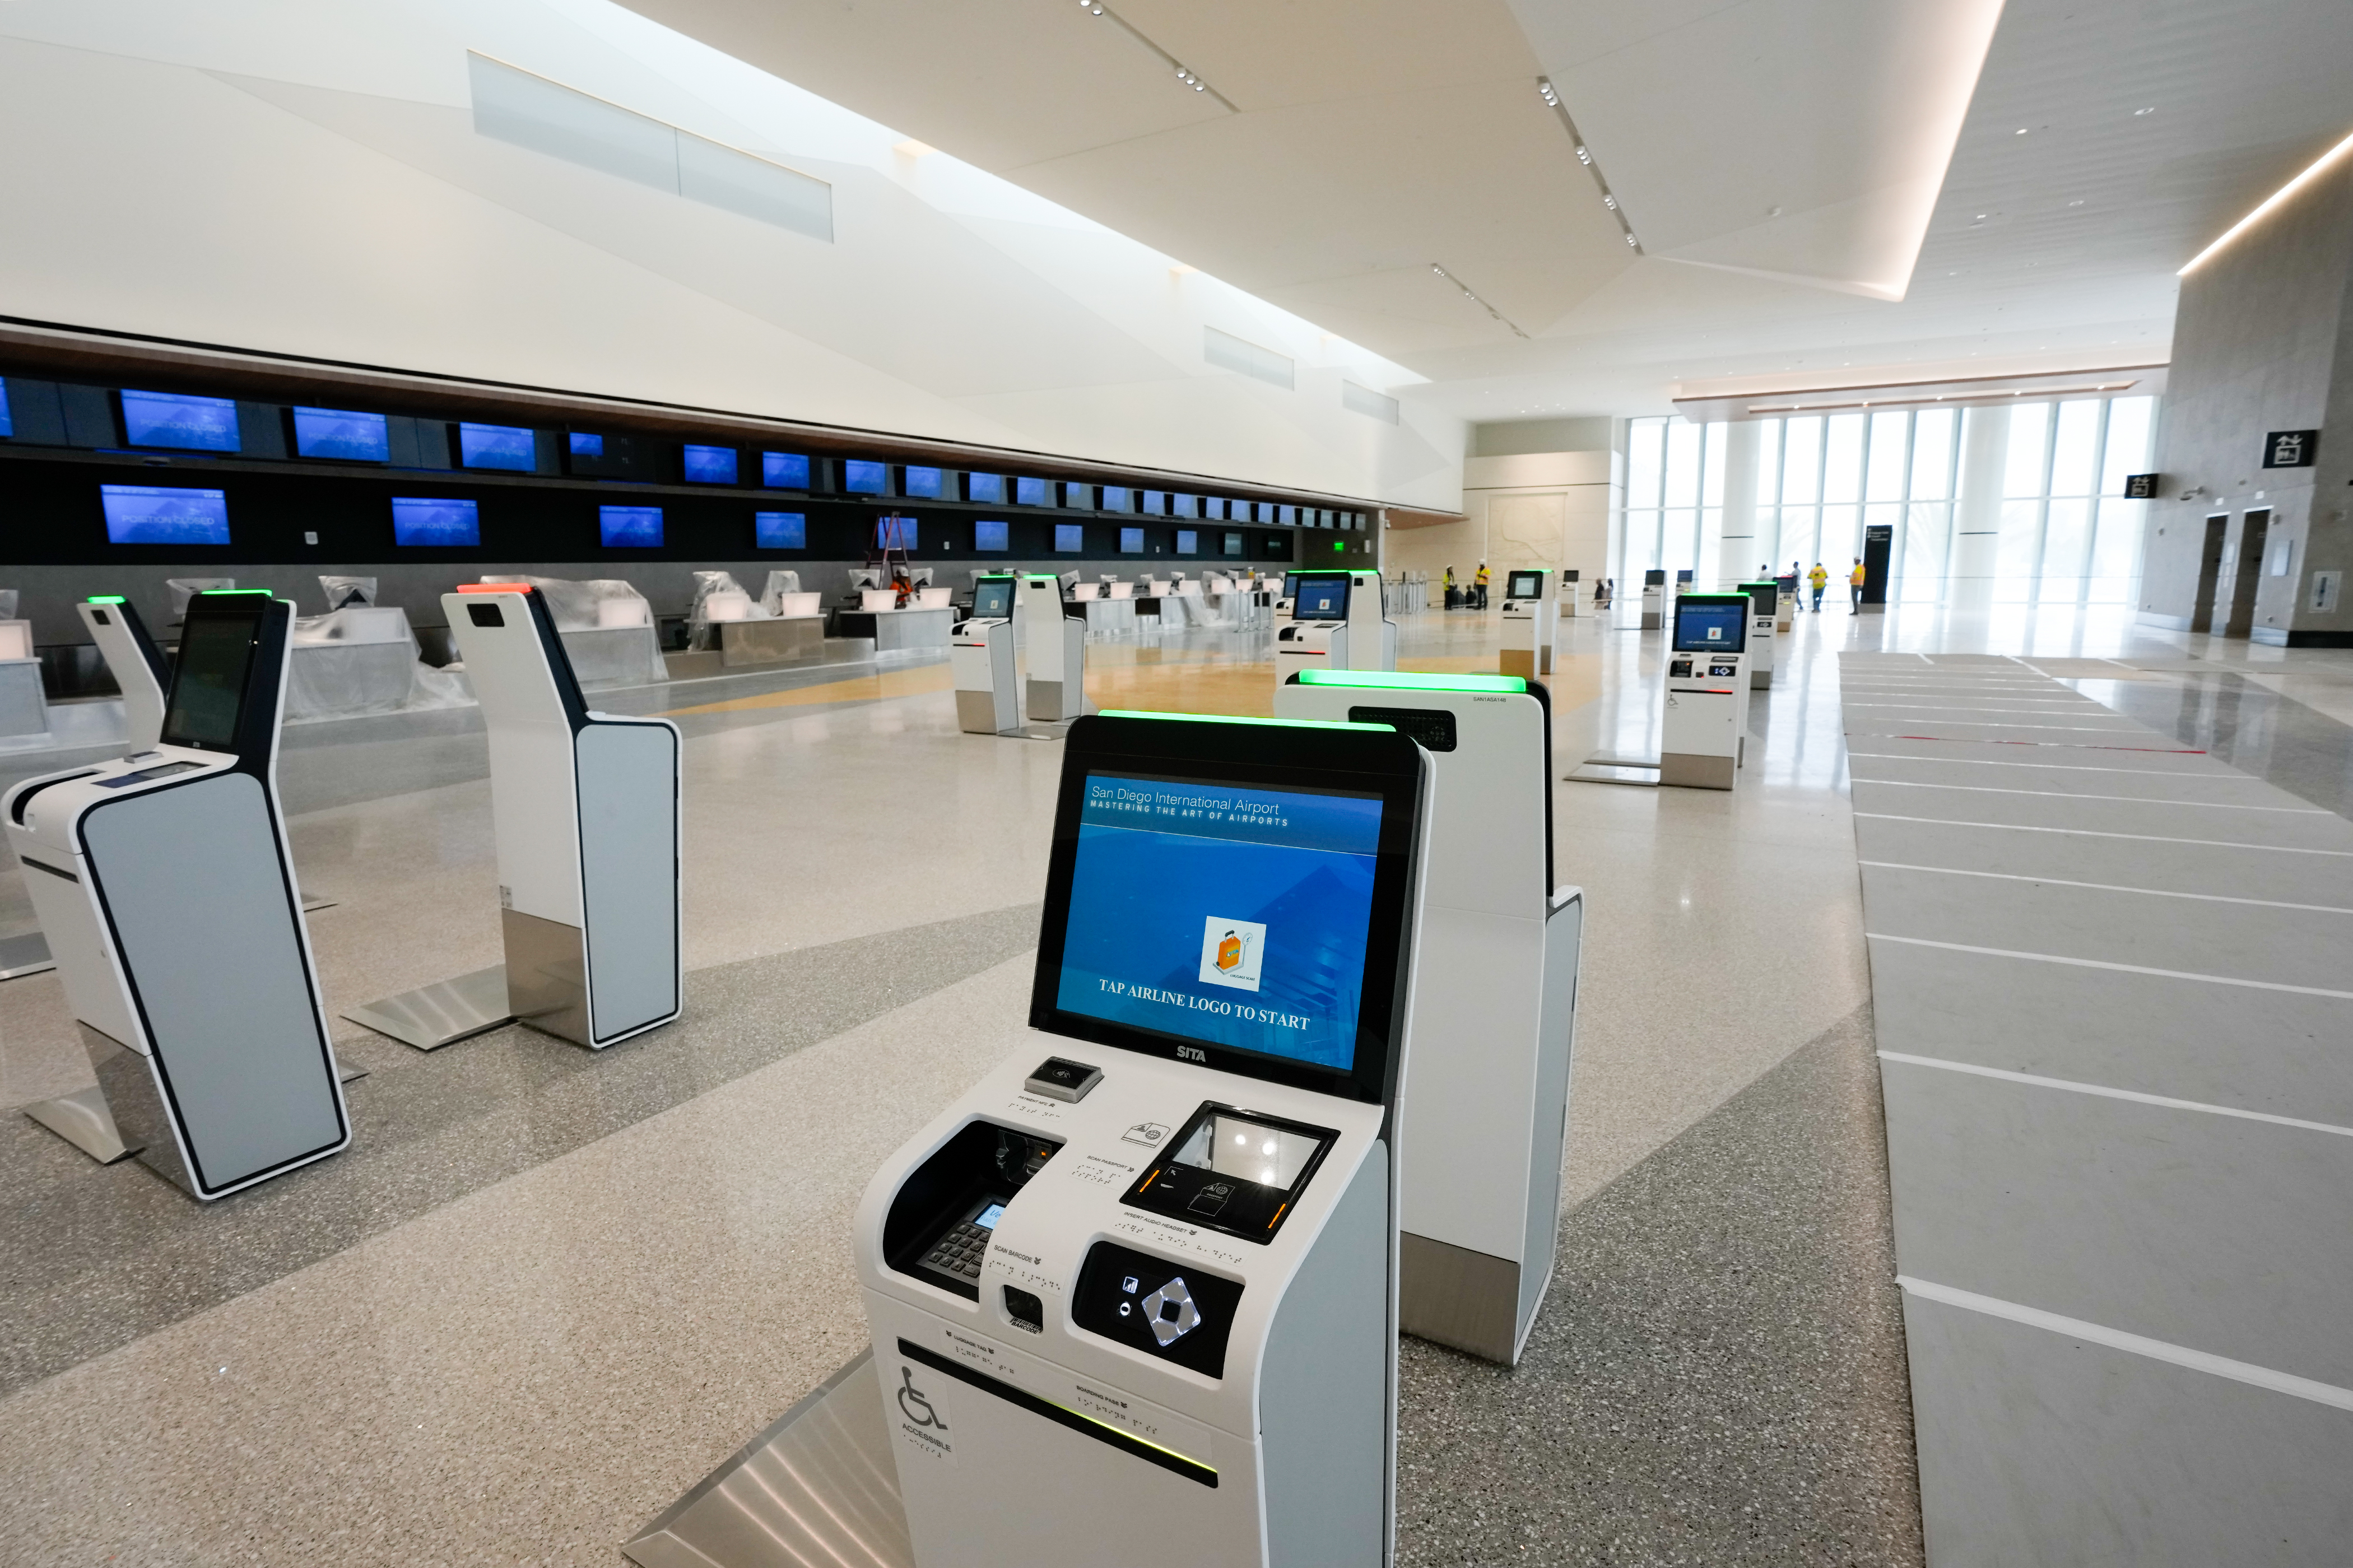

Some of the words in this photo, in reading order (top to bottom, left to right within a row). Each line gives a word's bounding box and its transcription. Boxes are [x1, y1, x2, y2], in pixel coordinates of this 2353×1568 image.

[1092, 786, 1113, 798] San
[1117, 788, 1152, 804] Diego
[1156, 792, 1231, 810] International
[1234, 799, 1280, 815] Airport
[1090, 800, 1150, 812] MASTERING
[1156, 806, 1175, 815] THE
[1182, 809, 1203, 818] ART
[1209, 812, 1222, 820] OF
[1229, 813, 1288, 826] AIRPORTS
[1099, 979, 1125, 994] TAP
[1127, 985, 1185, 1007] AIRLINE
[1188, 995, 1231, 1015] LOGO
[1234, 1004, 1255, 1020] TO
[1258, 1009, 1310, 1030] START
[1176, 1045, 1206, 1062] SITA
[1101, 1159, 1128, 1169] PASSPORT
[1124, 1211, 1144, 1220] INSERT
[1143, 1217, 1161, 1226] AUDIO
[1161, 1223, 1188, 1234] HEADSET
[994, 1245, 1008, 1254] SCAN
[1008, 1250, 1033, 1263] BARCODE
[1011, 1321, 1040, 1334] BARCODE
[954, 1335, 976, 1348] LUGGAGE
[1076, 1385, 1104, 1400] BOARDING
[1105, 1397, 1119, 1406] PASS
[902, 1423, 951, 1453] ACCESSIBLE
